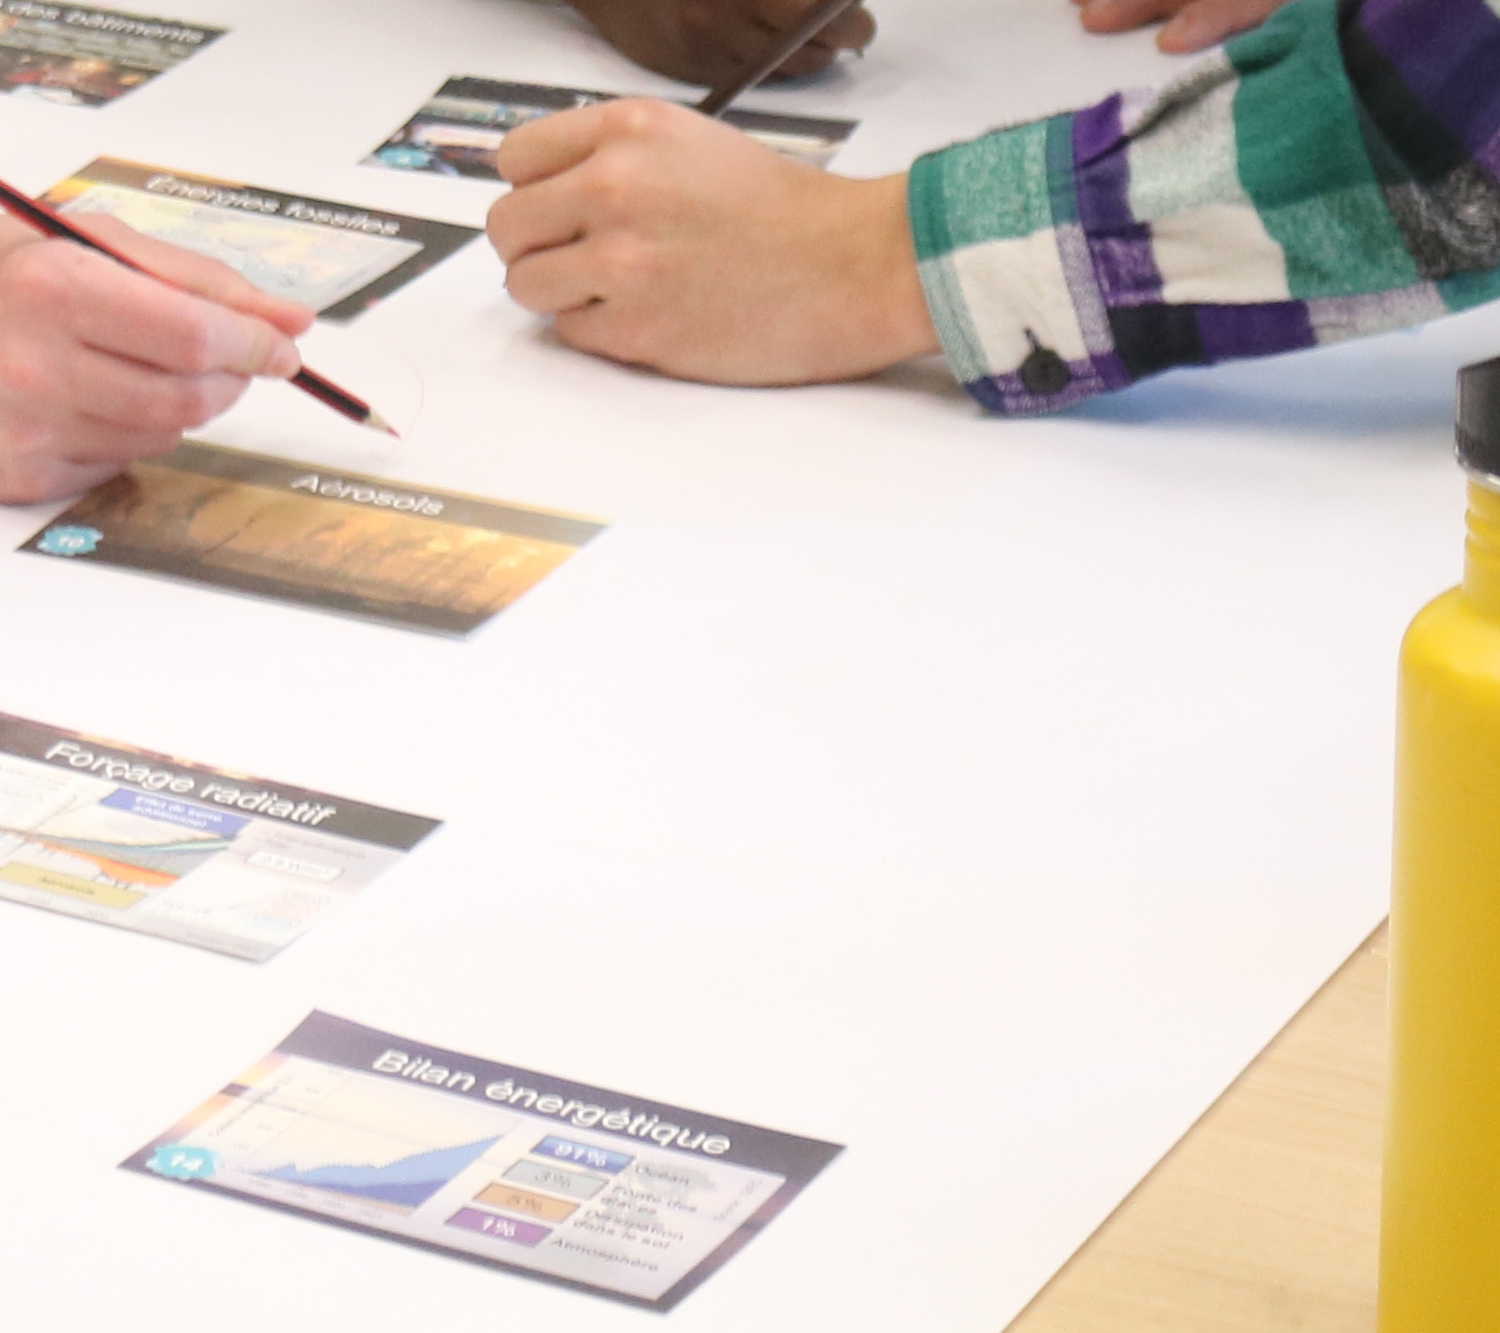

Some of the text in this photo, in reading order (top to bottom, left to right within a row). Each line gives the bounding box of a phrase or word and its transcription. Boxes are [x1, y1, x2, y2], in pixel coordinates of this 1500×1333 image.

[44, 739, 197, 799] Forçage
[197, 775, 339, 827] radiatif
[373, 1047, 731, 1158] Bilan énergétique
[169, 1153, 204, 1173] 14
